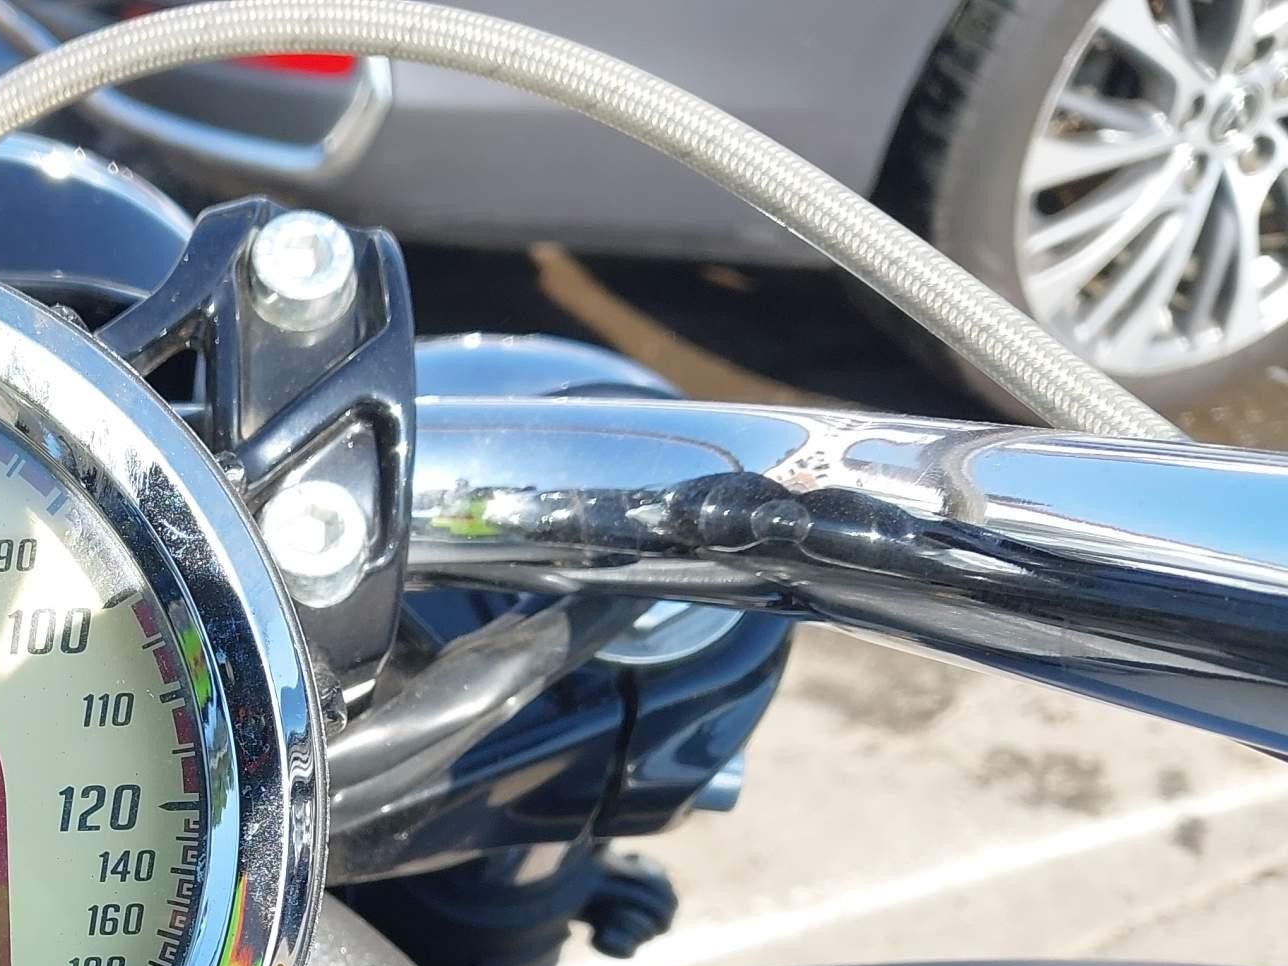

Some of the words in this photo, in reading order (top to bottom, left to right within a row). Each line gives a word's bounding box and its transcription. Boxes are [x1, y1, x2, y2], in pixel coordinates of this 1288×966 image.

[8, 608, 92, 655] 100
[83, 692, 134, 727] 110
[58, 784, 141, 832] 120
[98, 850, 156, 883] 140
[87, 904, 145, 936] 160
